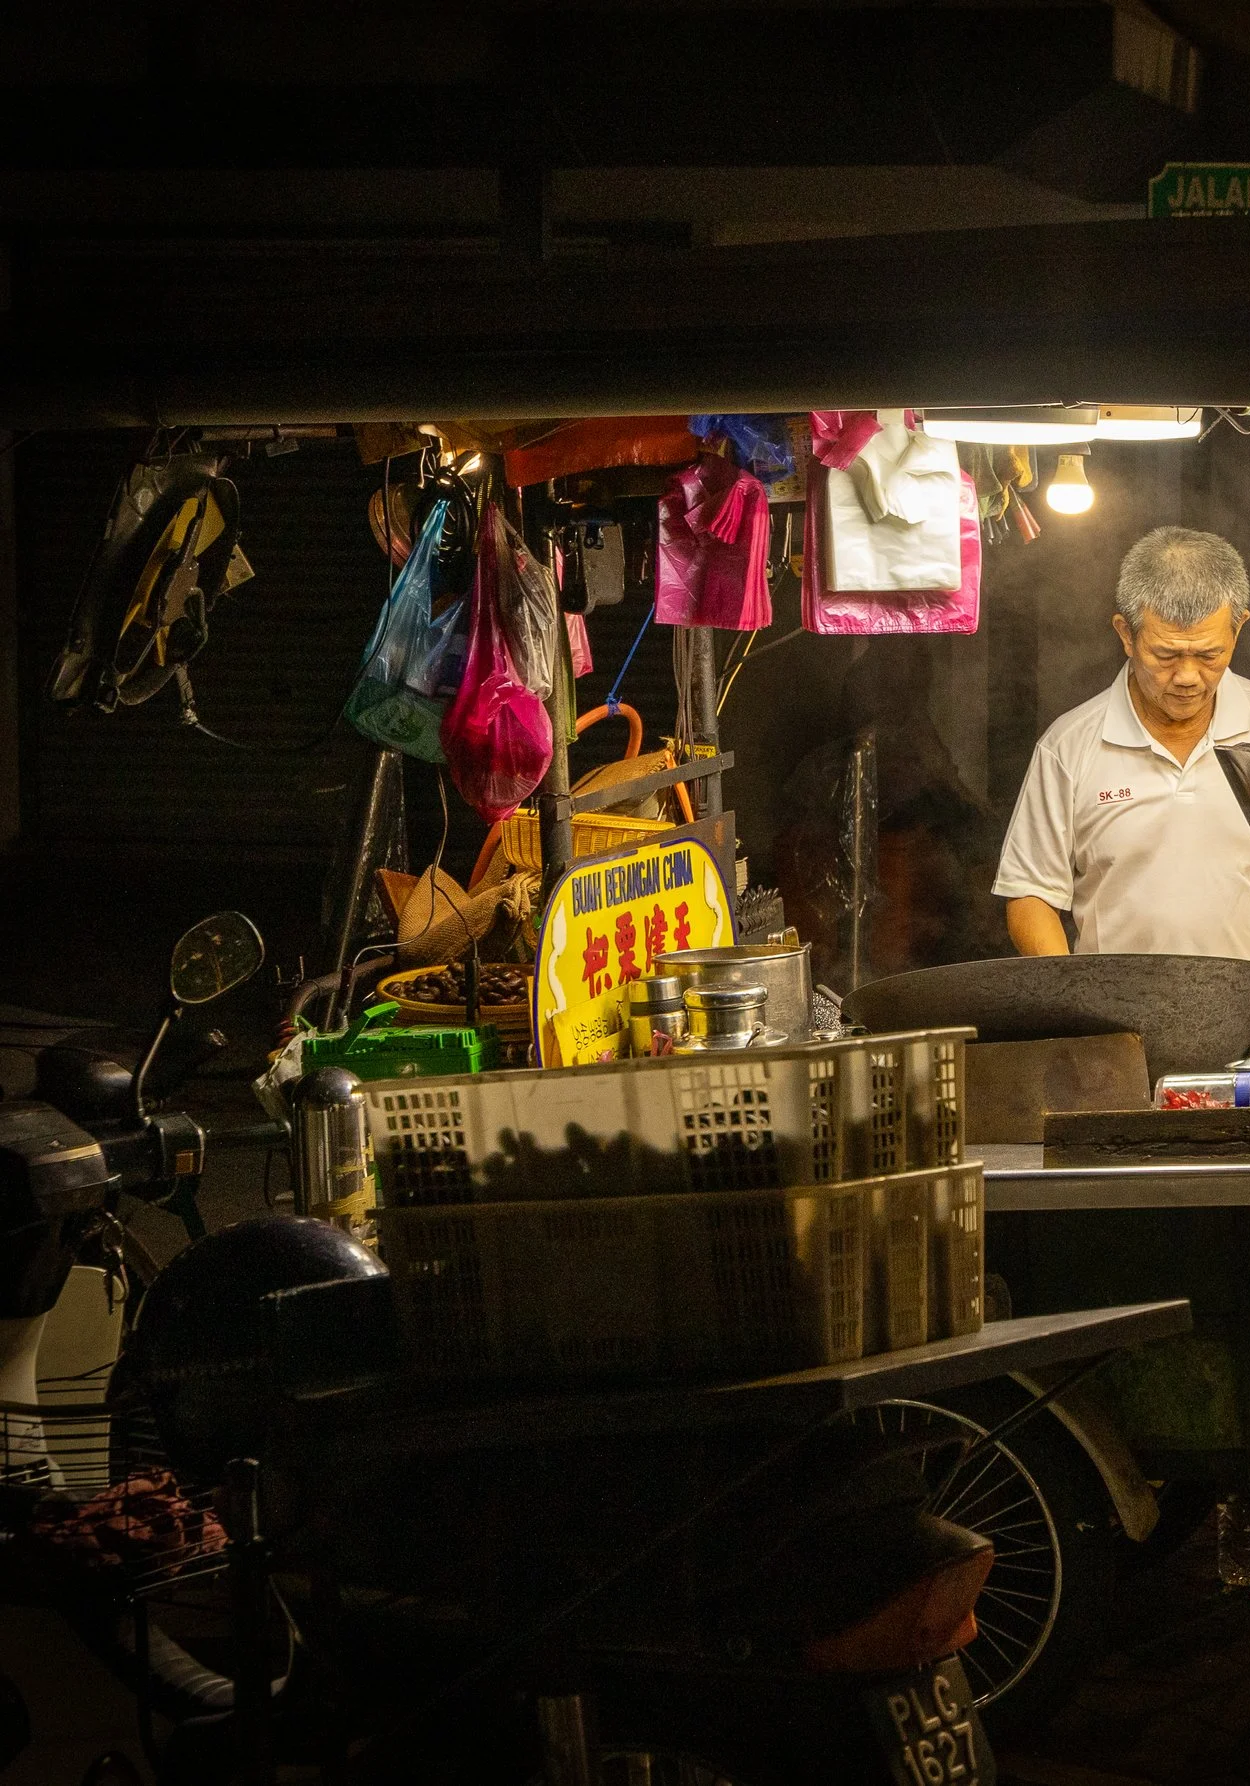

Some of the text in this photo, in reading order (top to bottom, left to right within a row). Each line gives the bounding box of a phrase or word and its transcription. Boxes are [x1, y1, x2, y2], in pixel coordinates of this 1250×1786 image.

[1099, 788, 1131, 801] SK-88
[572, 849, 694, 917] BUAH BERANGAN CHINA
[888, 1675, 958, 1742] PLC
[903, 1721, 978, 1786] 1627
